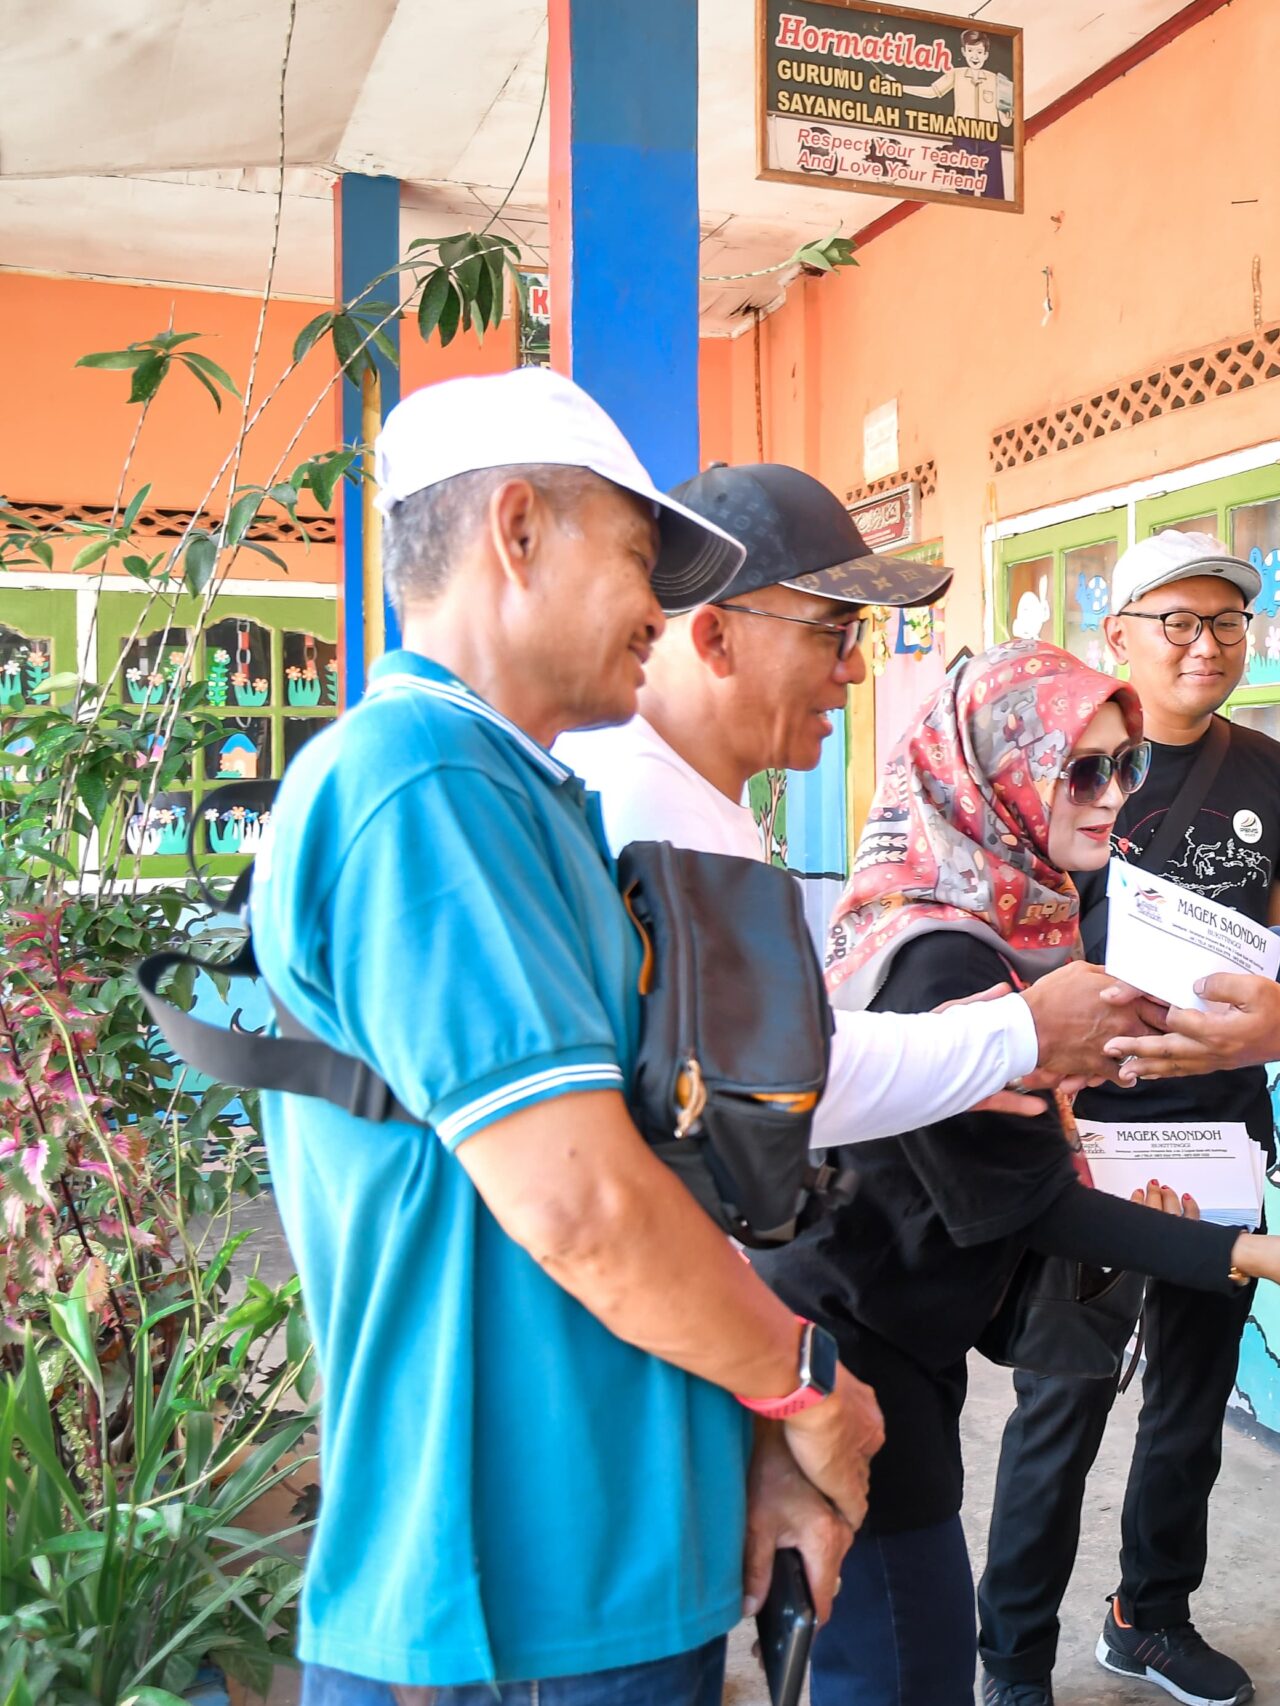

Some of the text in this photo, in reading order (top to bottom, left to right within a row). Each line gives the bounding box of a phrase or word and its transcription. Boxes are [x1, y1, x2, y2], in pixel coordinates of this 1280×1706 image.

[777, 15, 953, 72] Hormatilah
[777, 59, 903, 97] GURUMU dan
[777, 90, 999, 142] SAYANGILAH TEMANMU
[797, 128, 987, 169] Respect Your Teacher
[797, 151, 987, 190] And Love Your Friend
[1177, 899, 1218, 928] MAGEK
[1220, 917, 1267, 953] SAONDOH
[1116, 1130, 1222, 1142] MAGEK SAONDOH
